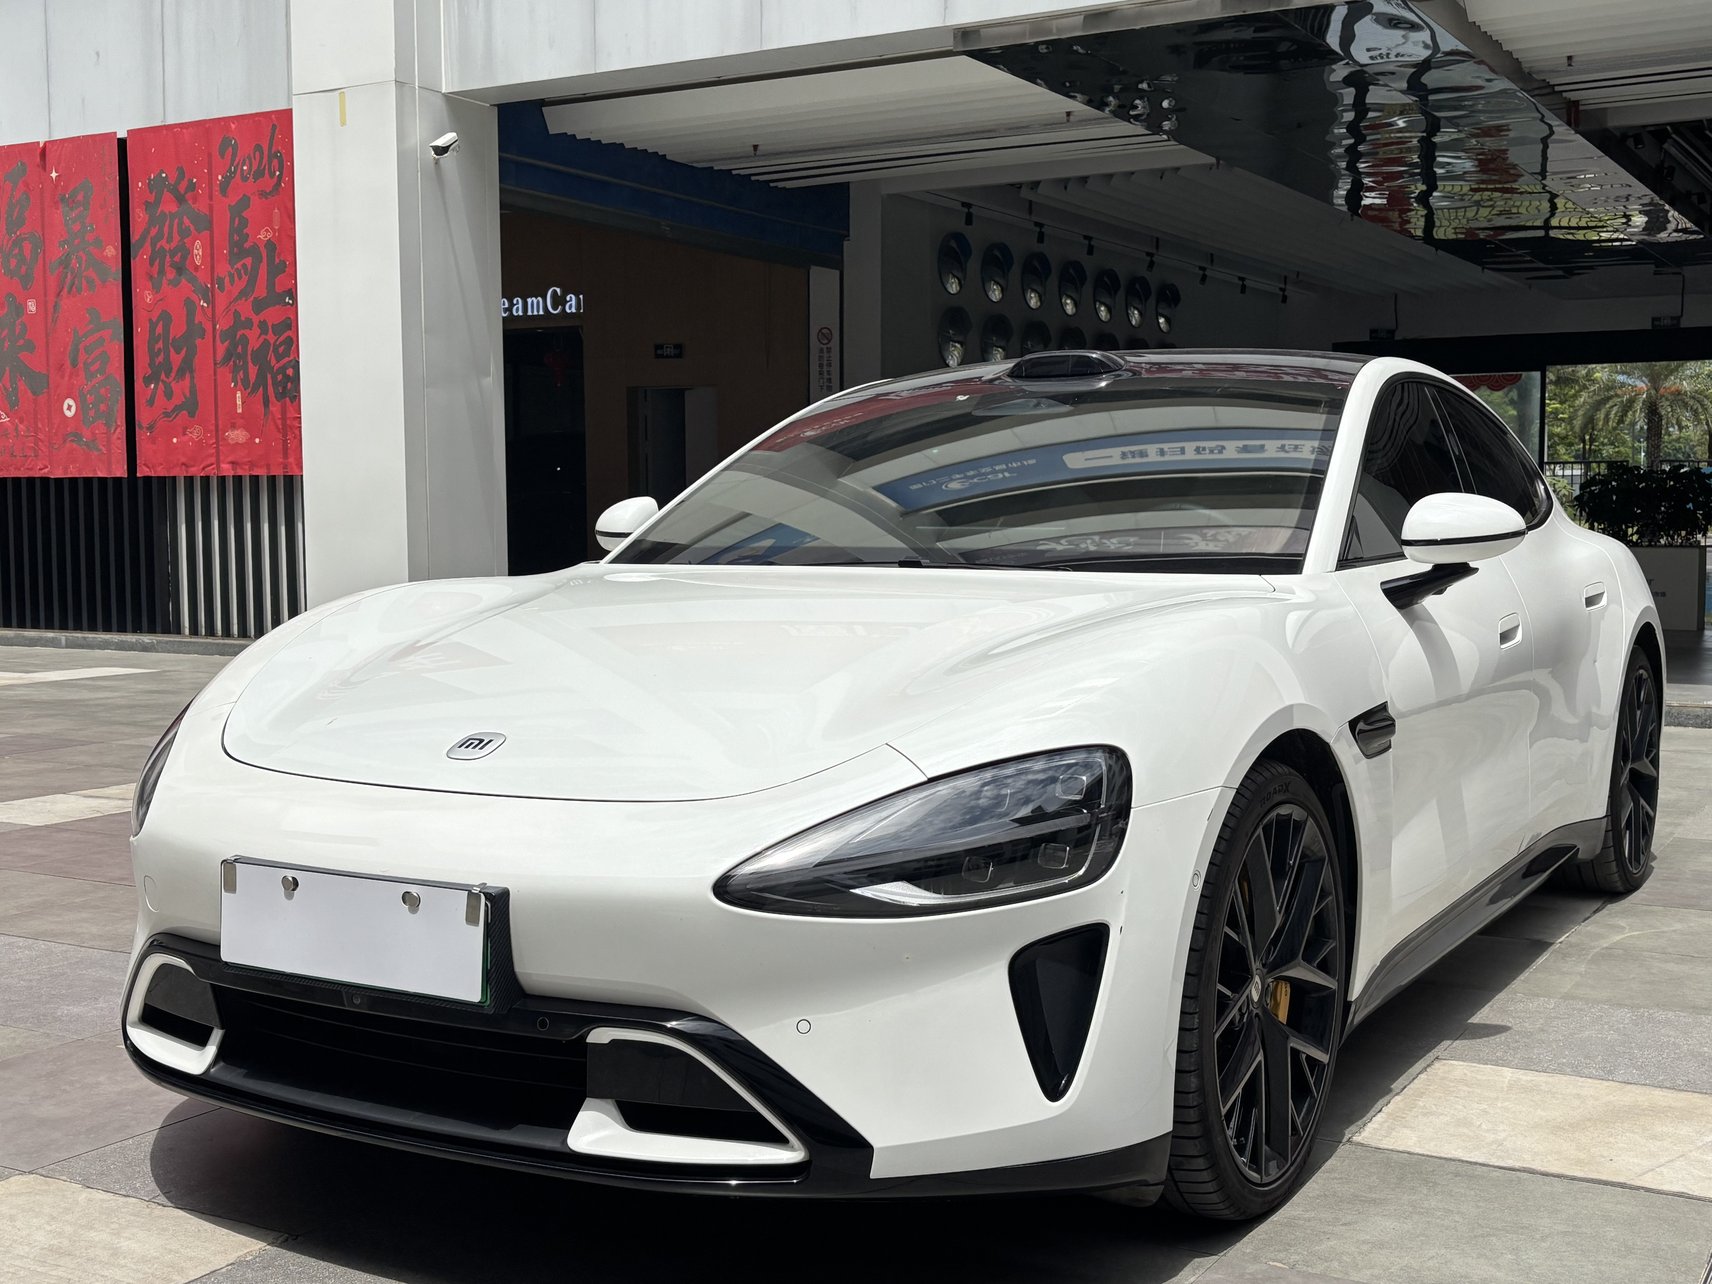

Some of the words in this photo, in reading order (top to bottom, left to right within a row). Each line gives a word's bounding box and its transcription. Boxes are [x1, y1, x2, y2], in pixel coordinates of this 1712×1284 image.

[217, 123, 284, 200] 2026
[48, 177, 123, 431] 暴富
[131, 166, 211, 420] 發財
